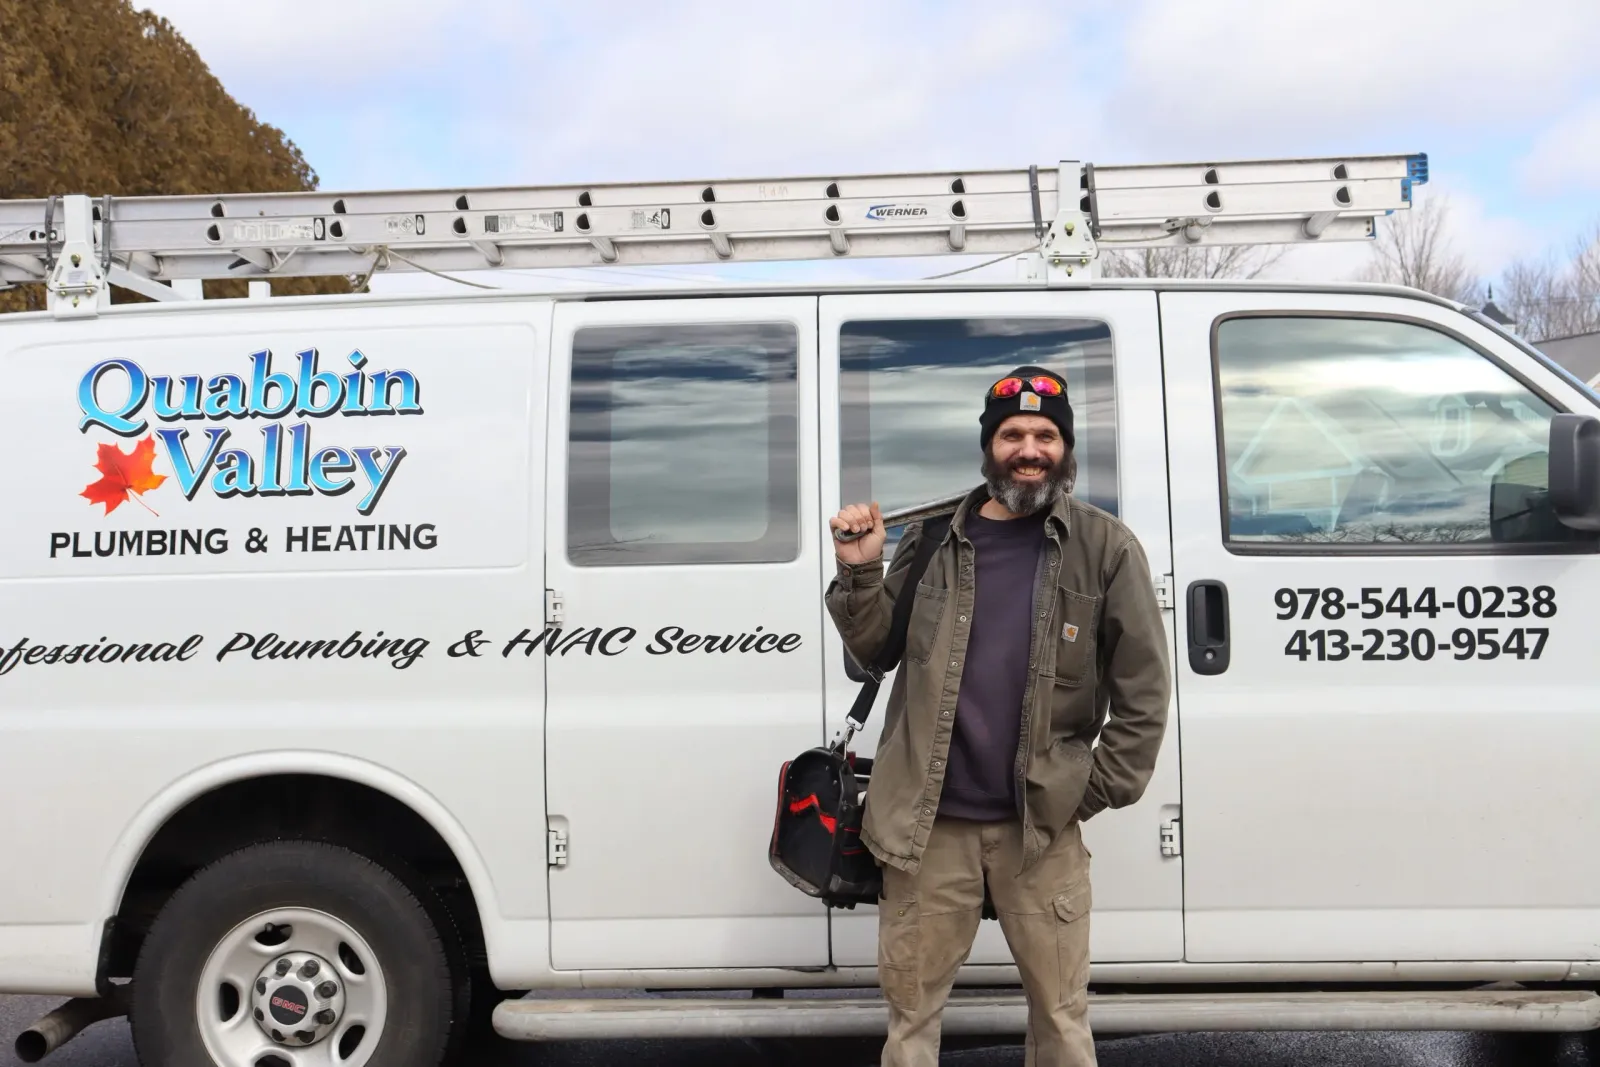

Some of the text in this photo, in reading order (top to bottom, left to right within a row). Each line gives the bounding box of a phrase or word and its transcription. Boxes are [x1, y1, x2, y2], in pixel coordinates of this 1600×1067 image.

[875, 207, 928, 217] WERNER
[77, 347, 425, 437] Quabbin
[155, 420, 408, 516] Valley
[50, 523, 438, 558] PLUMBING & HEATING
[1274, 585, 1558, 620] 978-544-0238
[0, 625, 803, 676] fessional Plumbing & HVAC Service
[1284, 627, 1550, 662] 413-230-9547
[272, 996, 305, 1015] GMC
